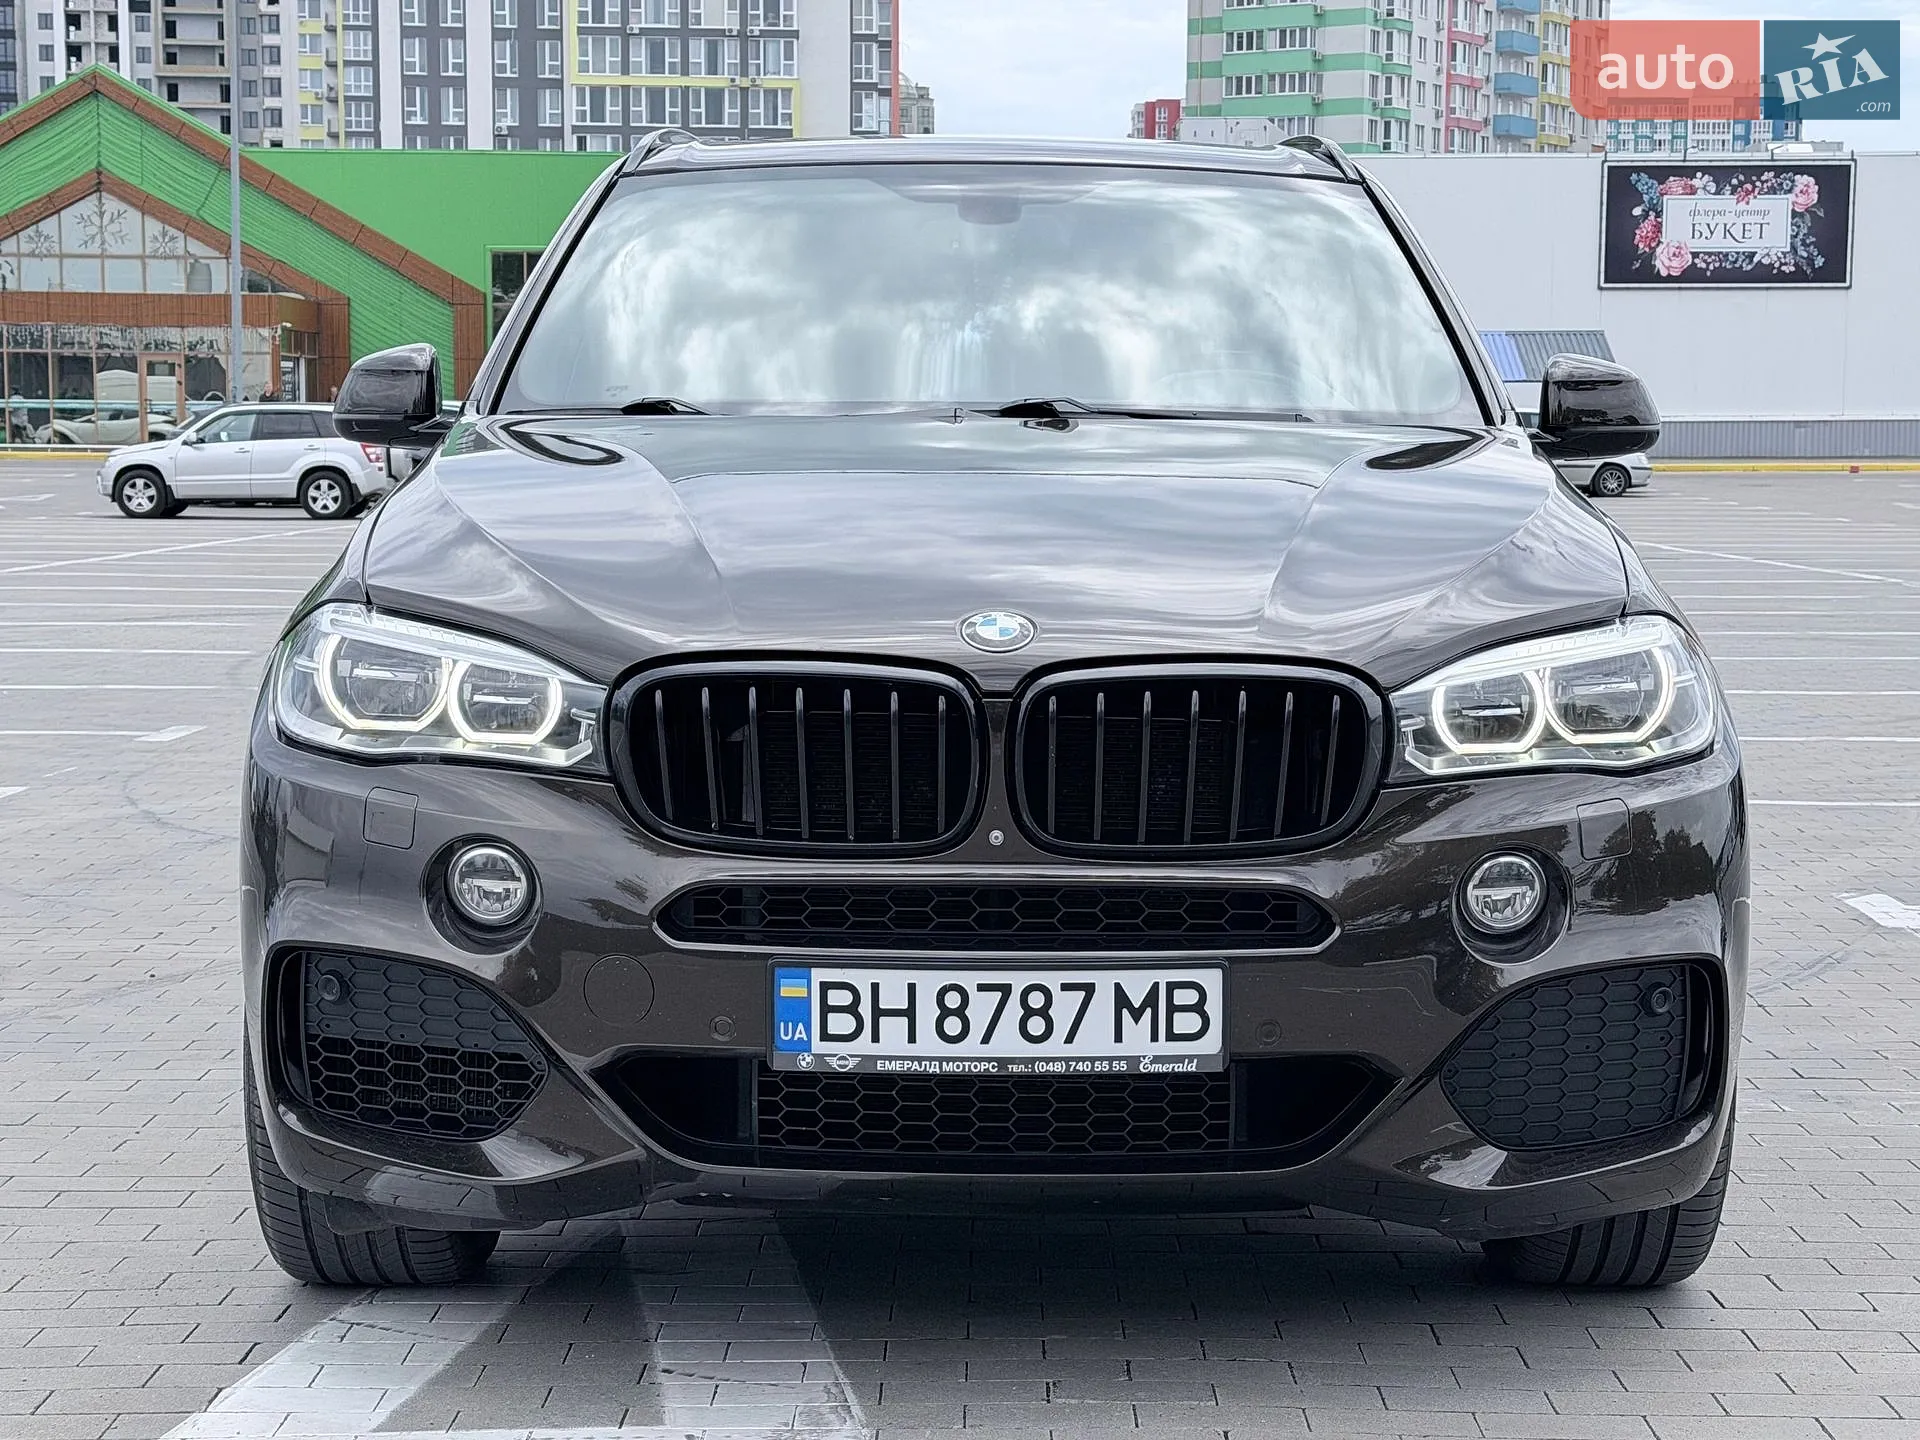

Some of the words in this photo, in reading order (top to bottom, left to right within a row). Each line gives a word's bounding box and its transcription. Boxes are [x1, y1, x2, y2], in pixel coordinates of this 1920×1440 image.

[1689, 202, 1771, 222] флора-центр
[1691, 222, 1770, 243] БУКЕТ
[818, 980, 917, 1044] BH
[934, 982, 1097, 1046] 8787
[1113, 980, 1211, 1044] MB
[779, 1022, 808, 1042] UA
[876, 1060, 940, 1073] ЕМЕРАЛД
[942, 1061, 998, 1073] МОТОРС
[1034, 1061, 1066, 1073] (048)
[1069, 1061, 1091, 1072] 740
[1094, 1061, 1110, 1072] 55
[1112, 1060, 1128, 1072] 55
[1138, 1055, 1198, 1073] Emerald
